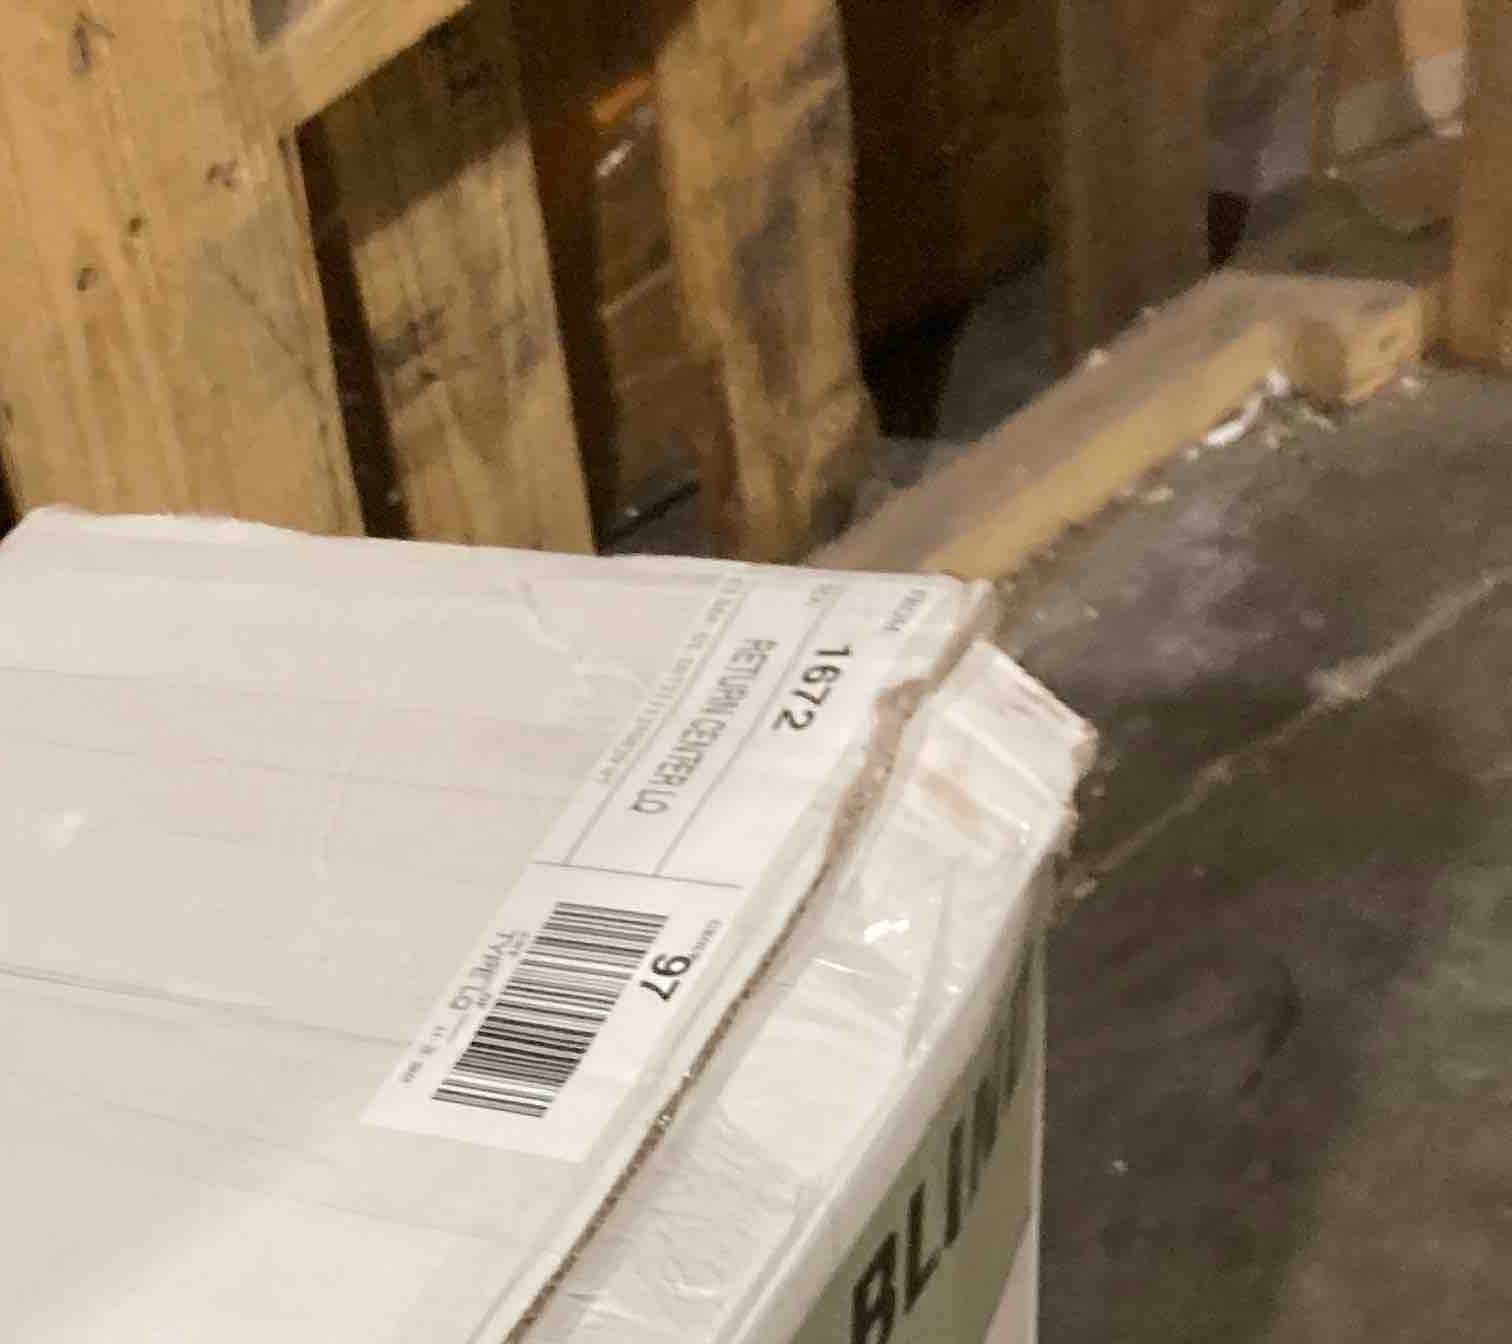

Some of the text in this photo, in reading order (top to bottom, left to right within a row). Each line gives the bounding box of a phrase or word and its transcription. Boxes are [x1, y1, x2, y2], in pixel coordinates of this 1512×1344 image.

[701, 637, 778, 716] RETURN
[771, 643, 852, 731] 1672
[649, 714, 727, 787] CENTER
[639, 953, 692, 1001] 97
